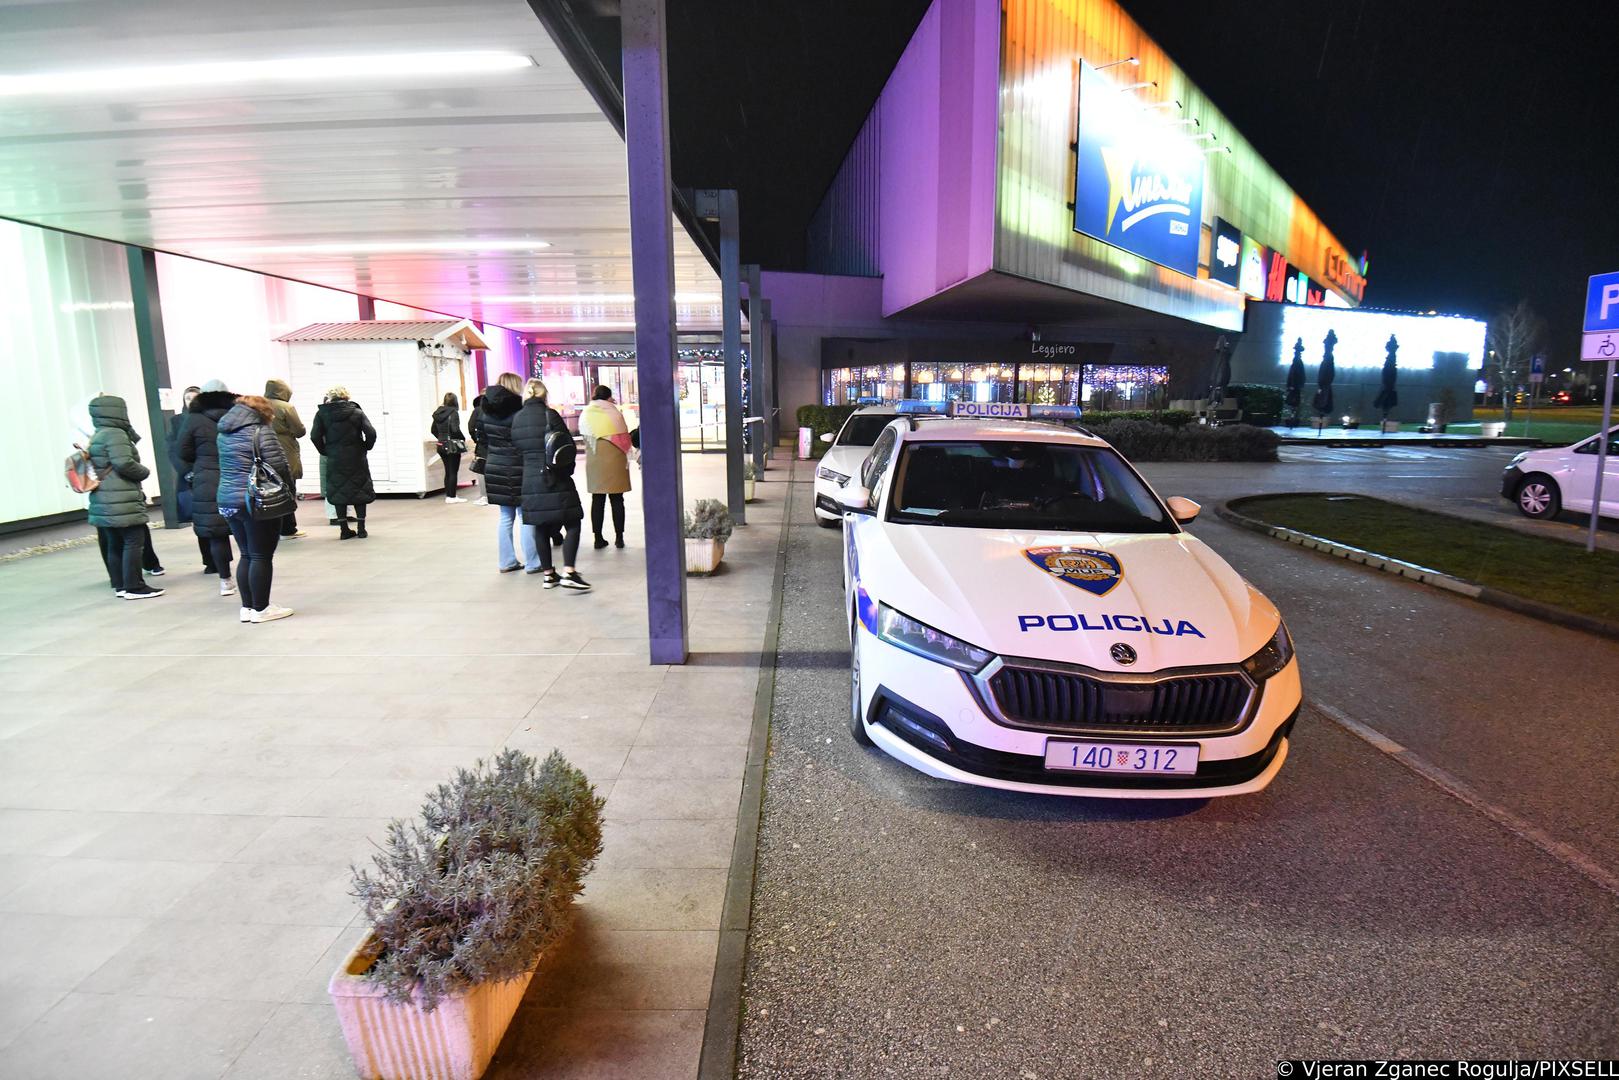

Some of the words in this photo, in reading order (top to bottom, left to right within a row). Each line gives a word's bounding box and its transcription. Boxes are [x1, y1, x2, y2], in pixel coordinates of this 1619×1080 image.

[1600, 284, 1619, 320] P
[1031, 342, 1076, 358] Leggiero
[957, 404, 1022, 416] POLICIJA
[1029, 547, 1111, 557] POLCIJA
[1018, 614, 1207, 639] POLICIJA
[1072, 746, 1113, 769] 140
[1133, 748, 1178, 771] 312
